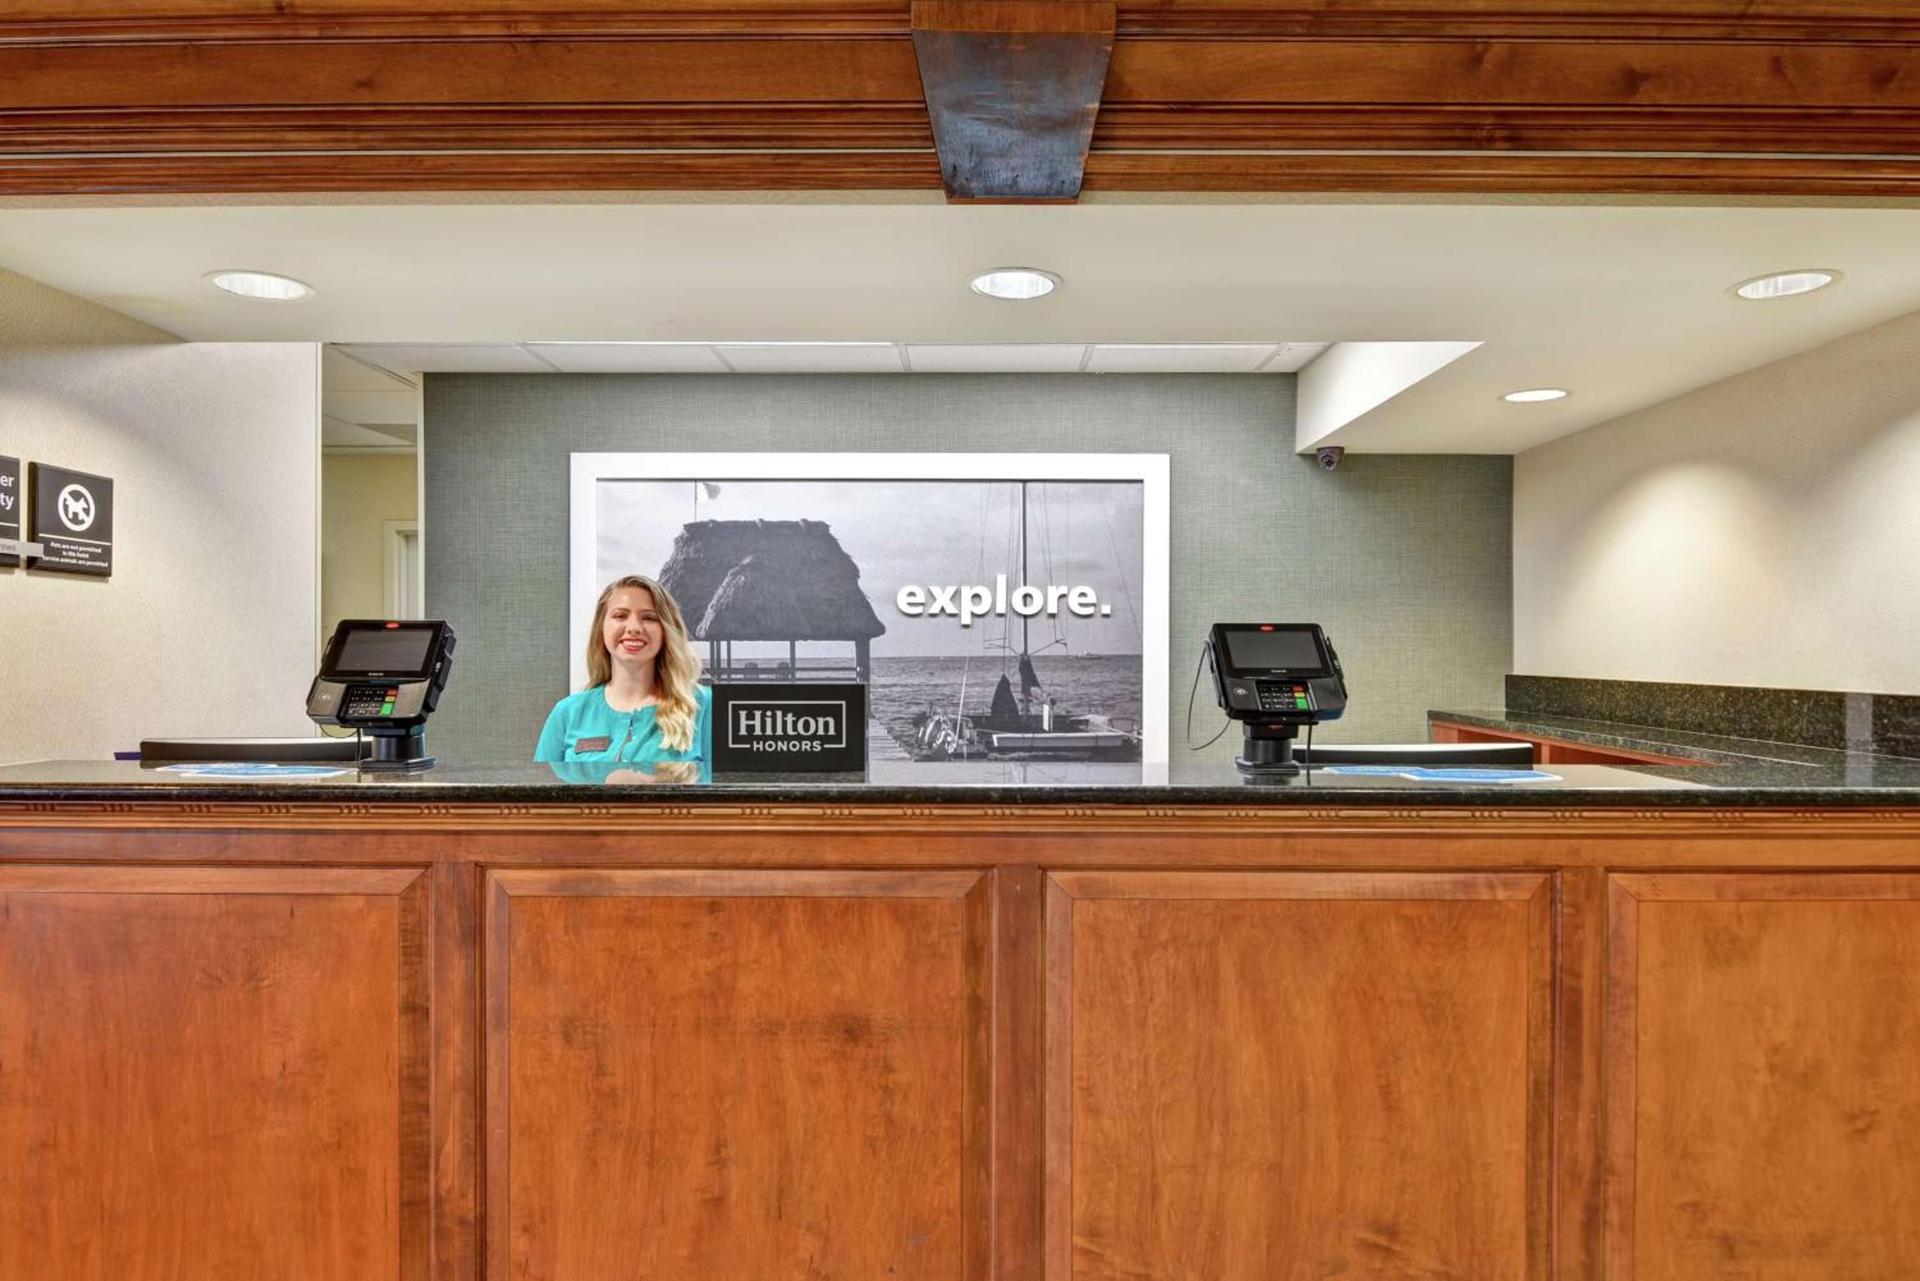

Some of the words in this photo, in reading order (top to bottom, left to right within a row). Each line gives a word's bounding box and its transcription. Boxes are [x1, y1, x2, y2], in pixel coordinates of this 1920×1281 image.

[896, 574, 1112, 627] explore.
[738, 710, 836, 736] Hilton
[753, 740, 822, 752] HONORS
